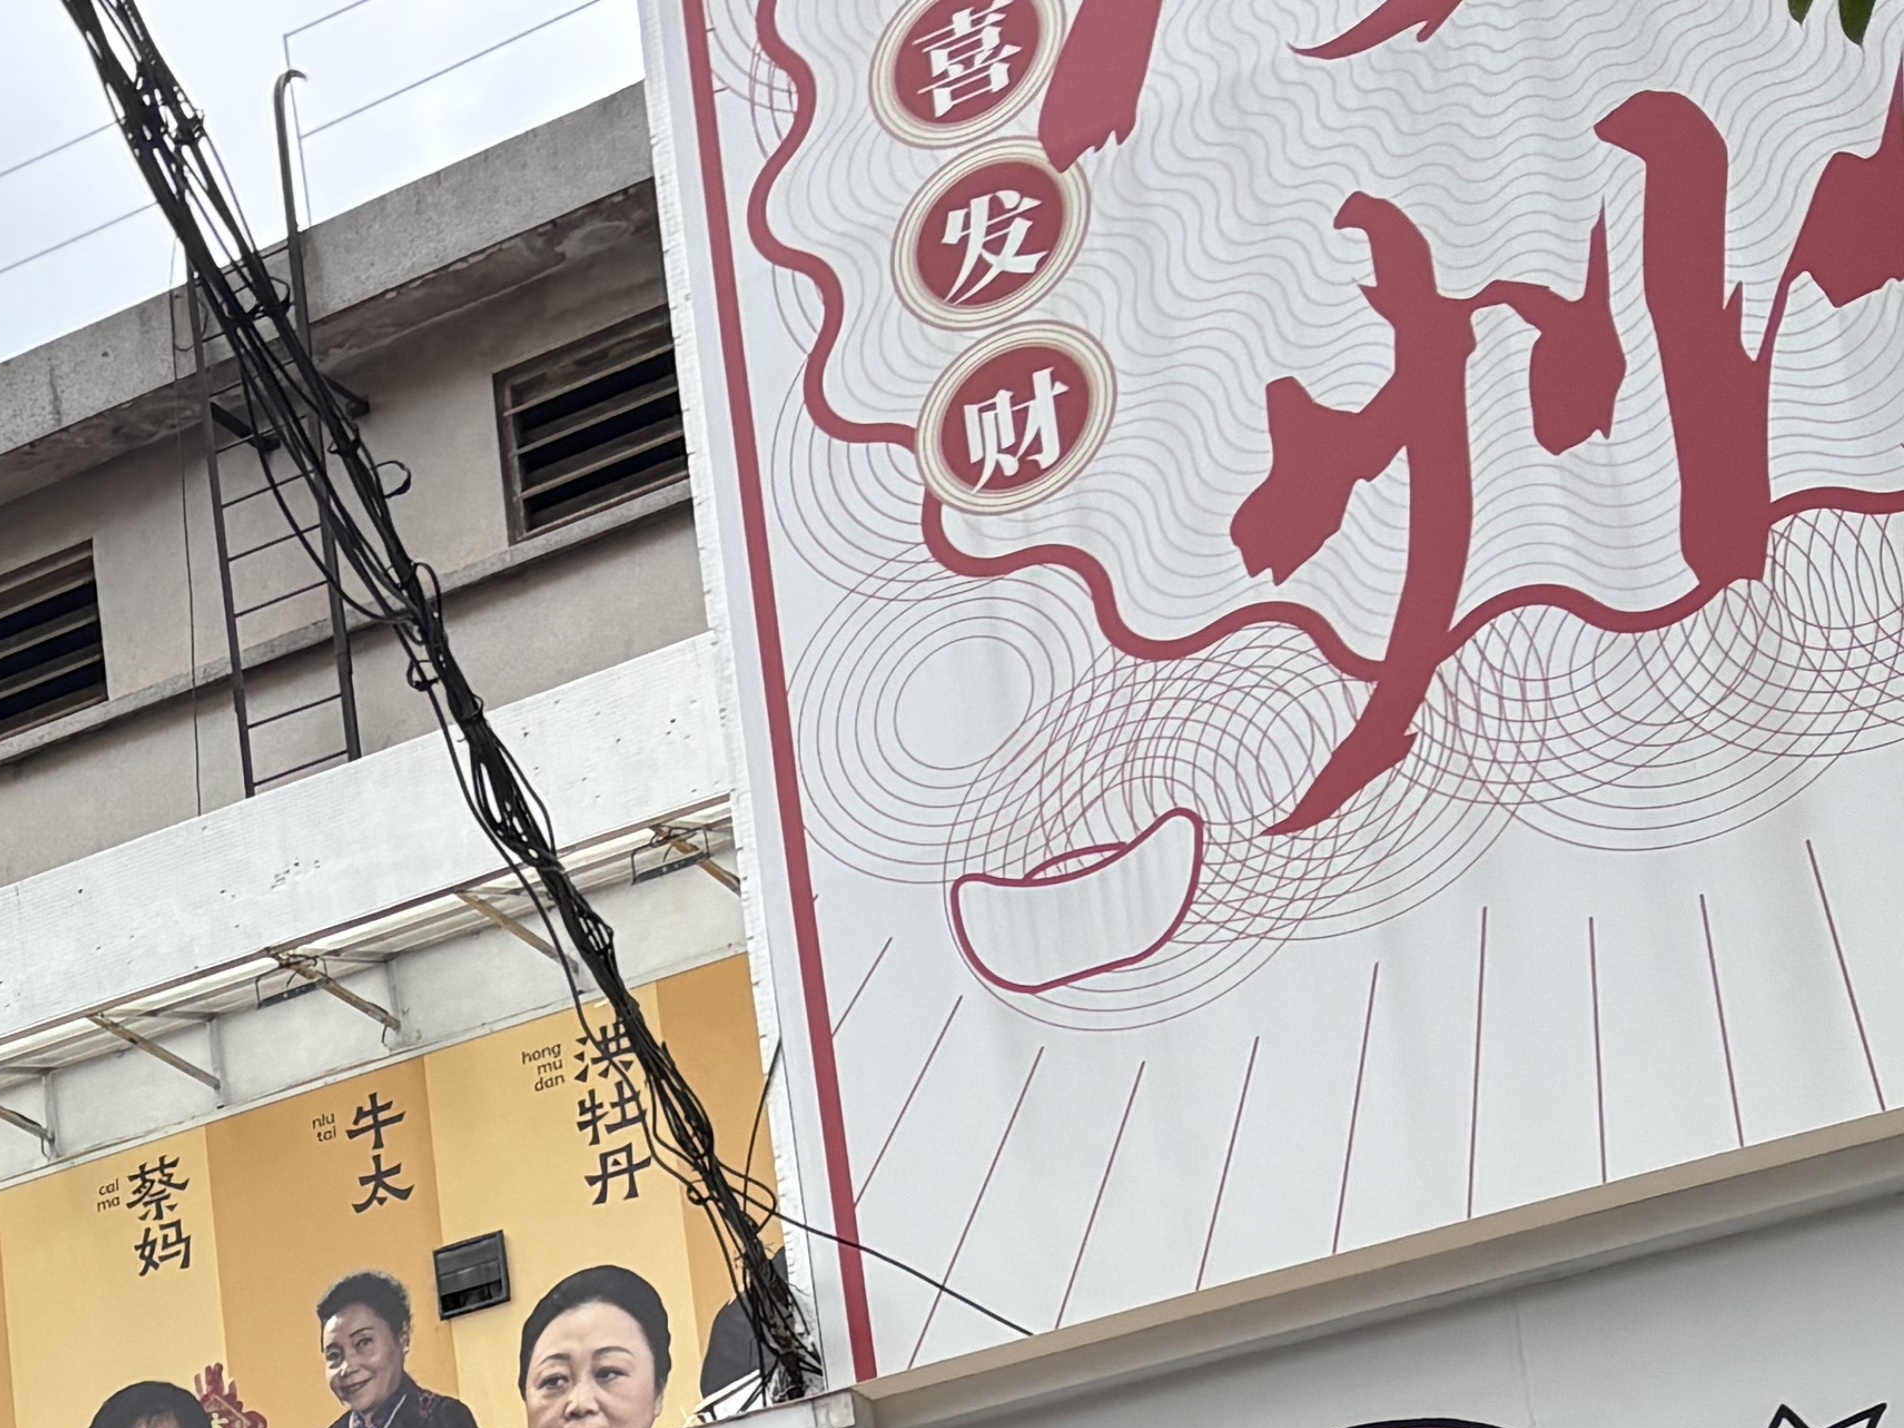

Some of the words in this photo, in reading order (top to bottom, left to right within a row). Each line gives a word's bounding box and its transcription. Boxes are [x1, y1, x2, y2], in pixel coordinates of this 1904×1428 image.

[522, 1042, 562, 1065] hong
[538, 1060, 563, 1076] mu
[534, 1071, 565, 1092] dan
[573, 1019, 651, 1205] 洪牡丹
[346, 1092, 415, 1214] 牛太
[98, 1178, 120, 1196] cai
[96, 1195, 121, 1212] ma
[126, 1154, 192, 1276] 蔡妈
